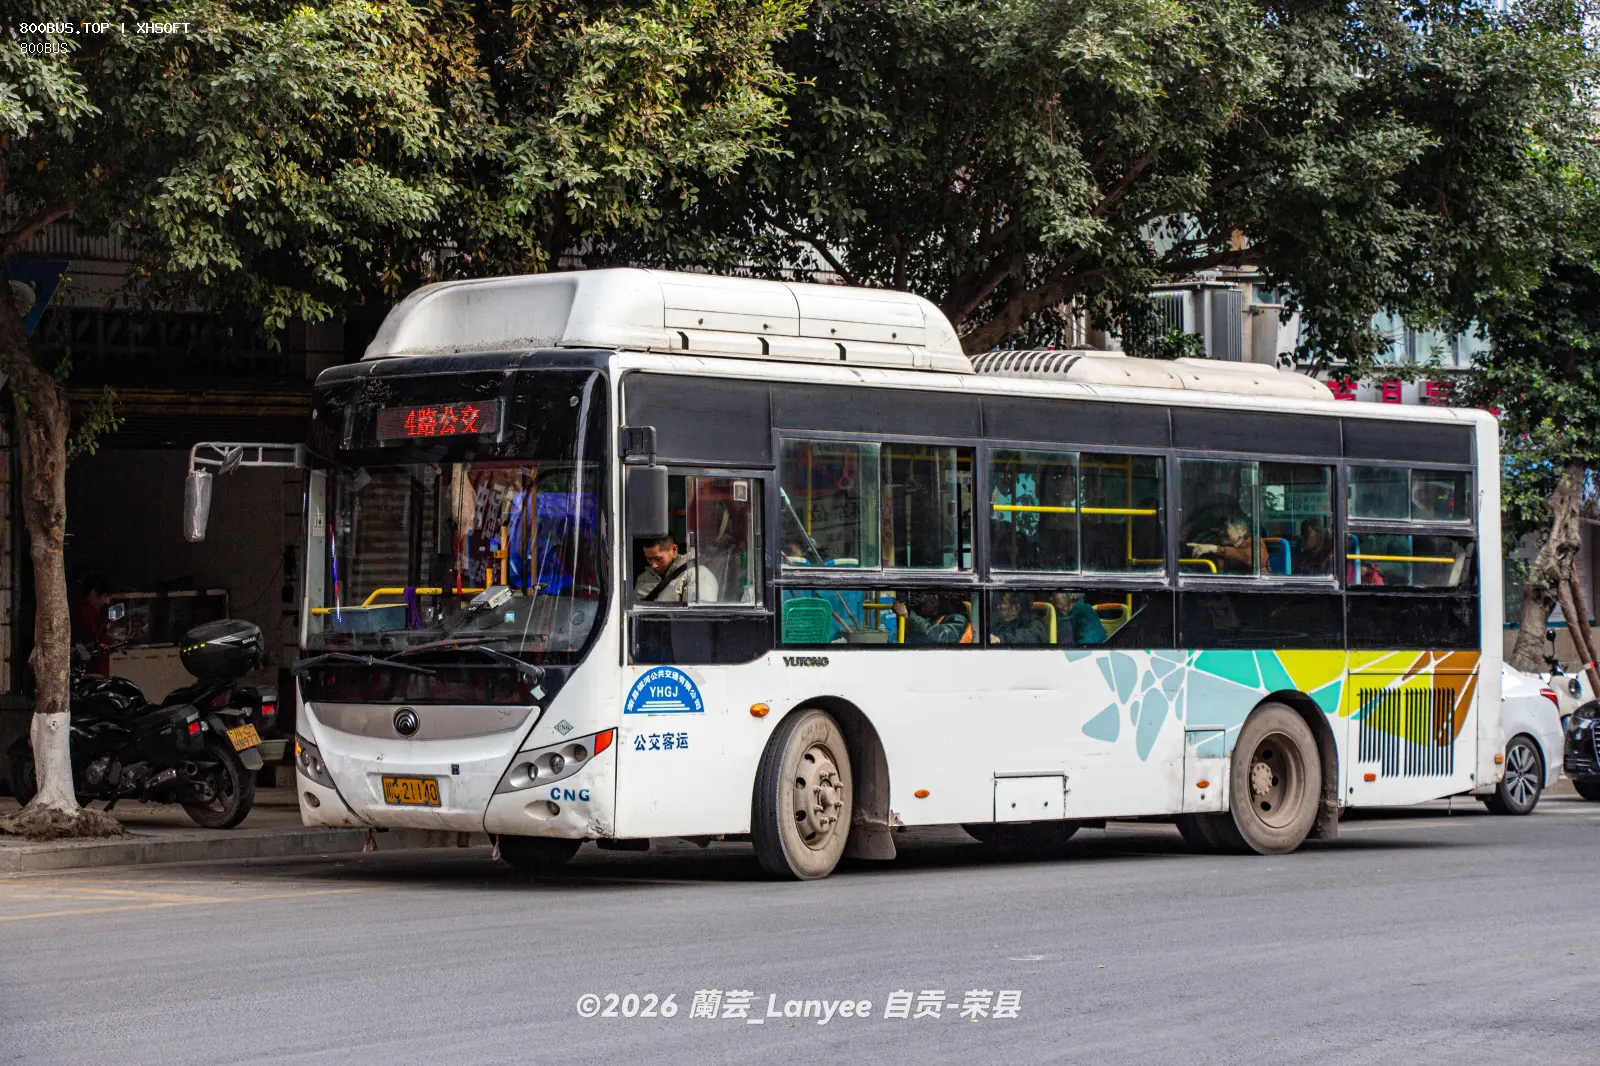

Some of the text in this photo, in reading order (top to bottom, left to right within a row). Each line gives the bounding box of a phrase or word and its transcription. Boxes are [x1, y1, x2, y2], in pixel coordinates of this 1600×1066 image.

[404, 404, 480, 436] 4路公交
[782, 656, 830, 667] YUTONG
[649, 685, 679, 698] YHGJ
[633, 732, 689, 751] 公交客运
[550, 787, 590, 801] CNG
